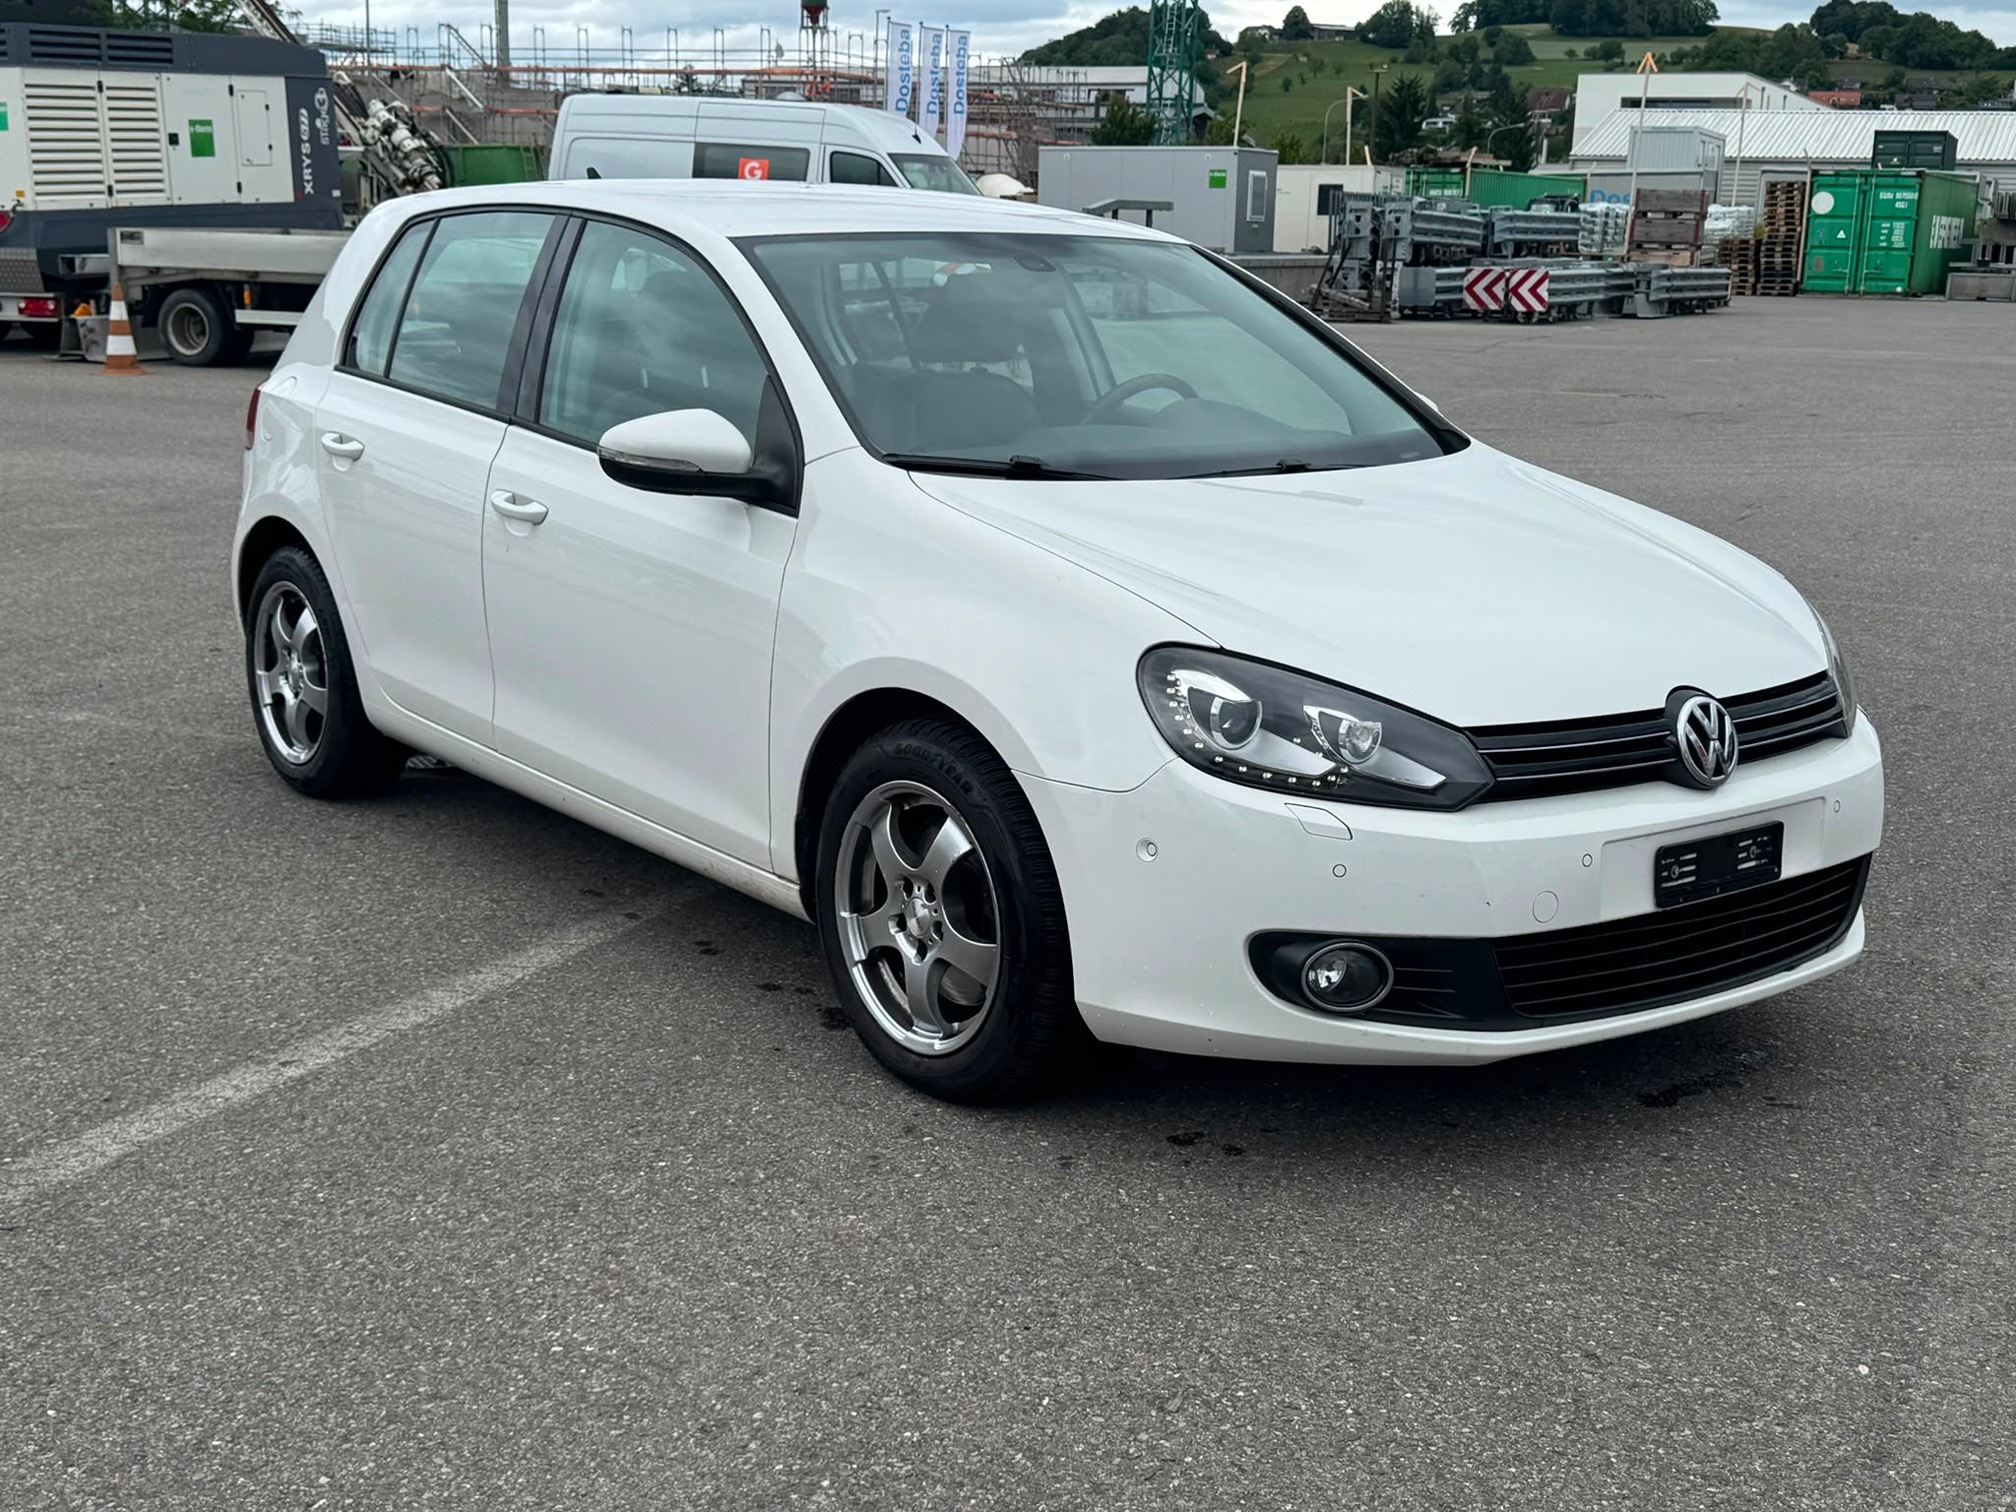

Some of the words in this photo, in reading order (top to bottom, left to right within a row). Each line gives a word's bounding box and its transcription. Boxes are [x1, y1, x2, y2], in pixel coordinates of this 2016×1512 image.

[895, 29, 911, 112] Dosteba
[926, 33, 942, 115] Dosteba
[953, 35, 968, 115] Dosteba
[744, 161, 762, 179] G
